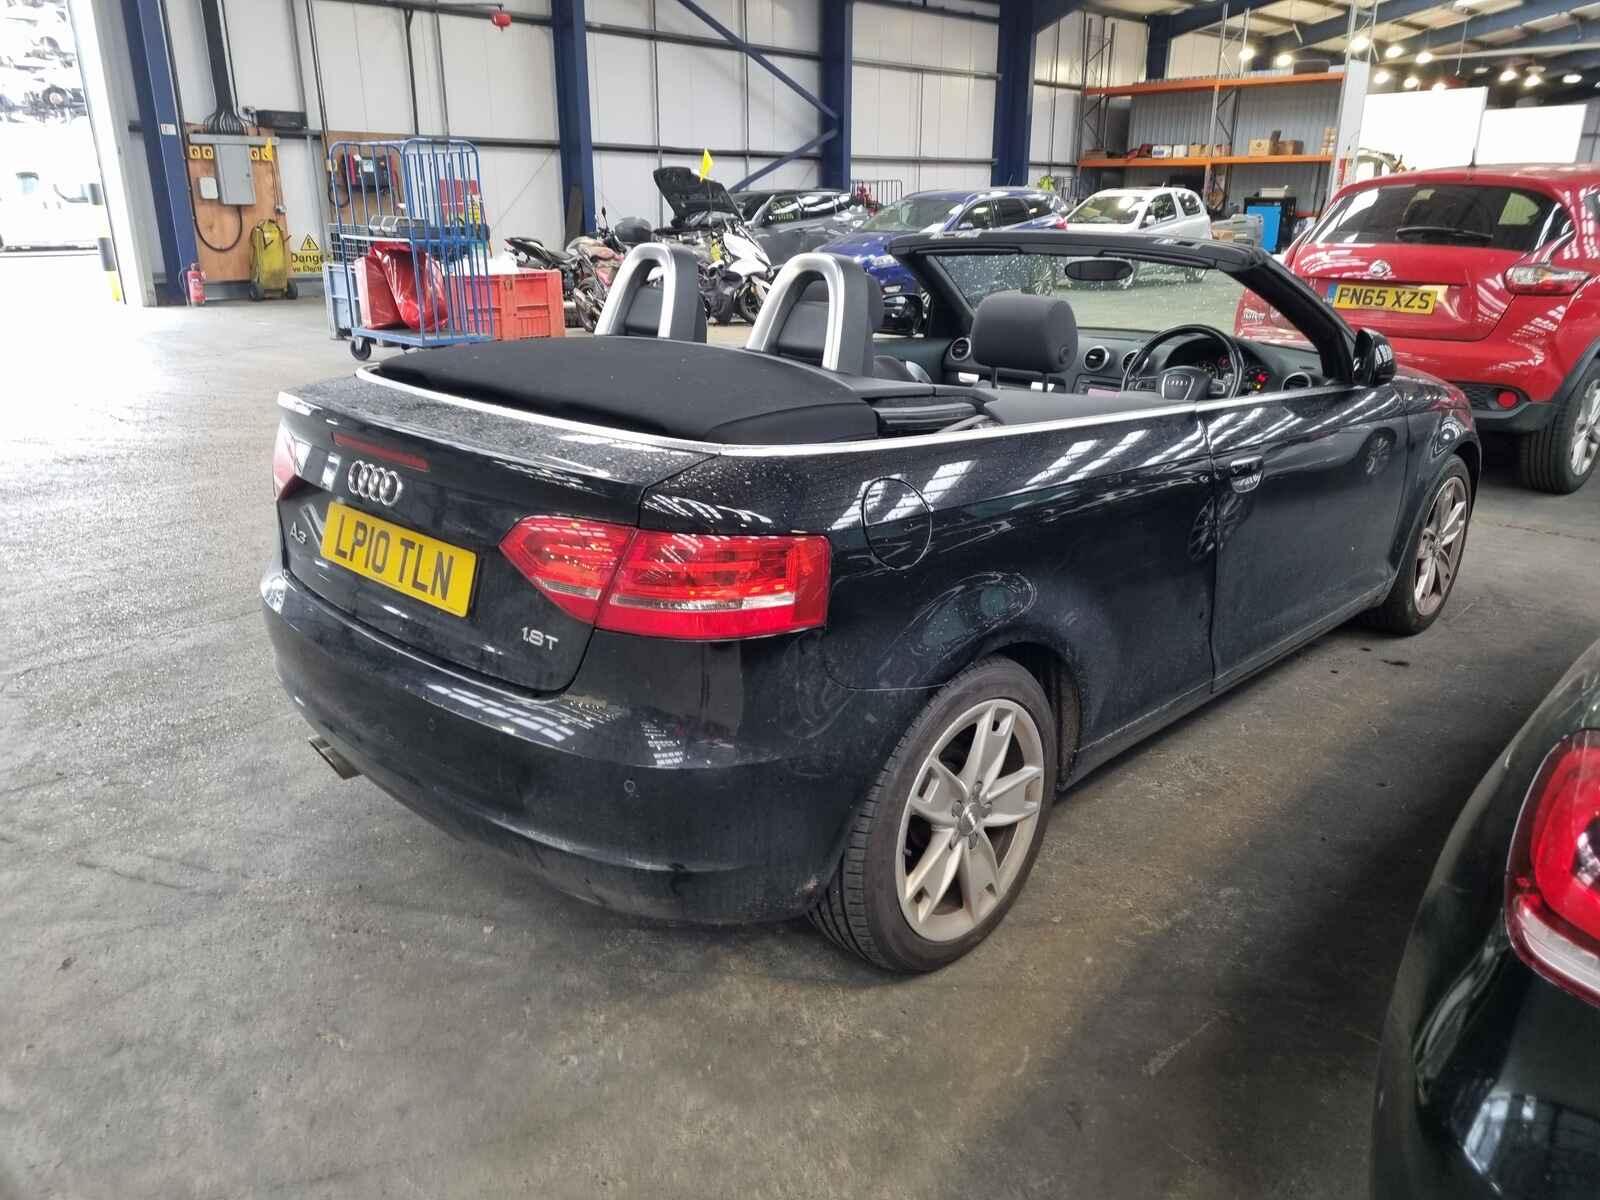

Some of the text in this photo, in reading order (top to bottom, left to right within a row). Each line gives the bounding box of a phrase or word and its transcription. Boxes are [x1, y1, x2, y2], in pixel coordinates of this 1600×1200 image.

[291, 252, 328, 265] Dange
[1337, 287, 1432, 310] PN65 XZS
[290, 520, 306, 544] A3
[334, 514, 455, 601] LP10 TLN
